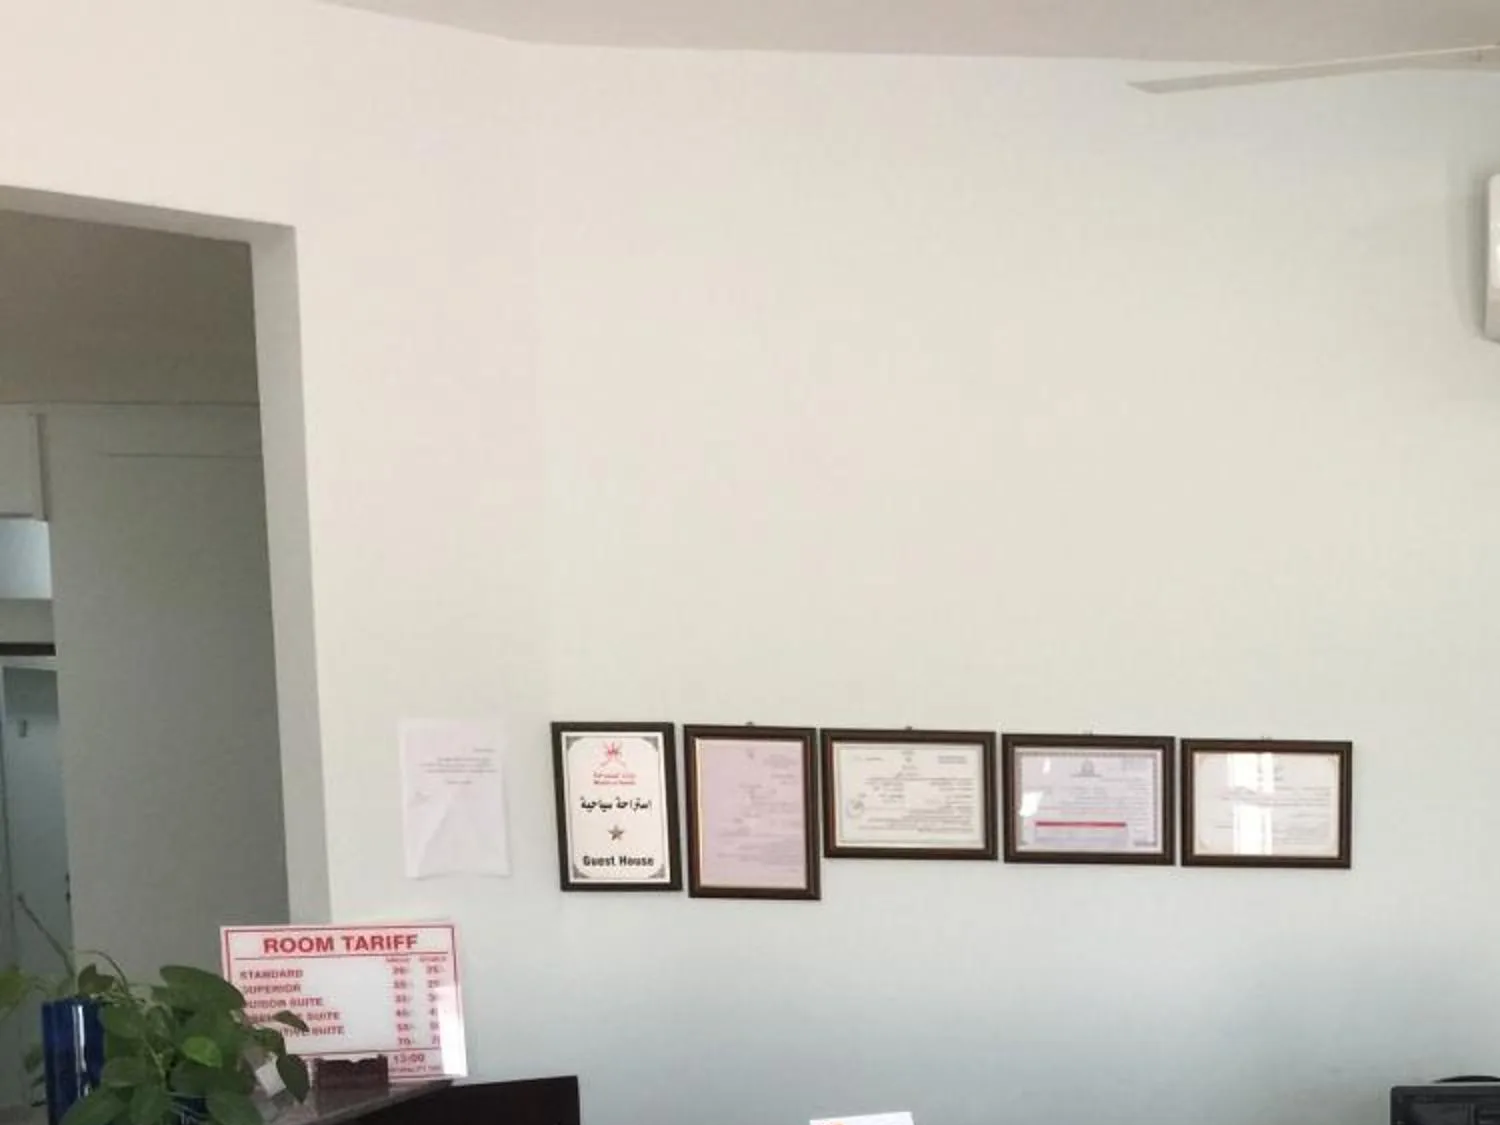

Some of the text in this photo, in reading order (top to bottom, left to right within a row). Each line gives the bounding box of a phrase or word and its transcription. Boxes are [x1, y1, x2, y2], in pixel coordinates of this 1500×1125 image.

[582, 855, 655, 867] Guest House
[263, 933, 419, 954] ROOM TARIFF
[240, 968, 304, 979] STANDARD
[289, 997, 323, 1007] SUITE
[306, 1011, 341, 1021] SUITE
[311, 1025, 345, 1035] SUITE
